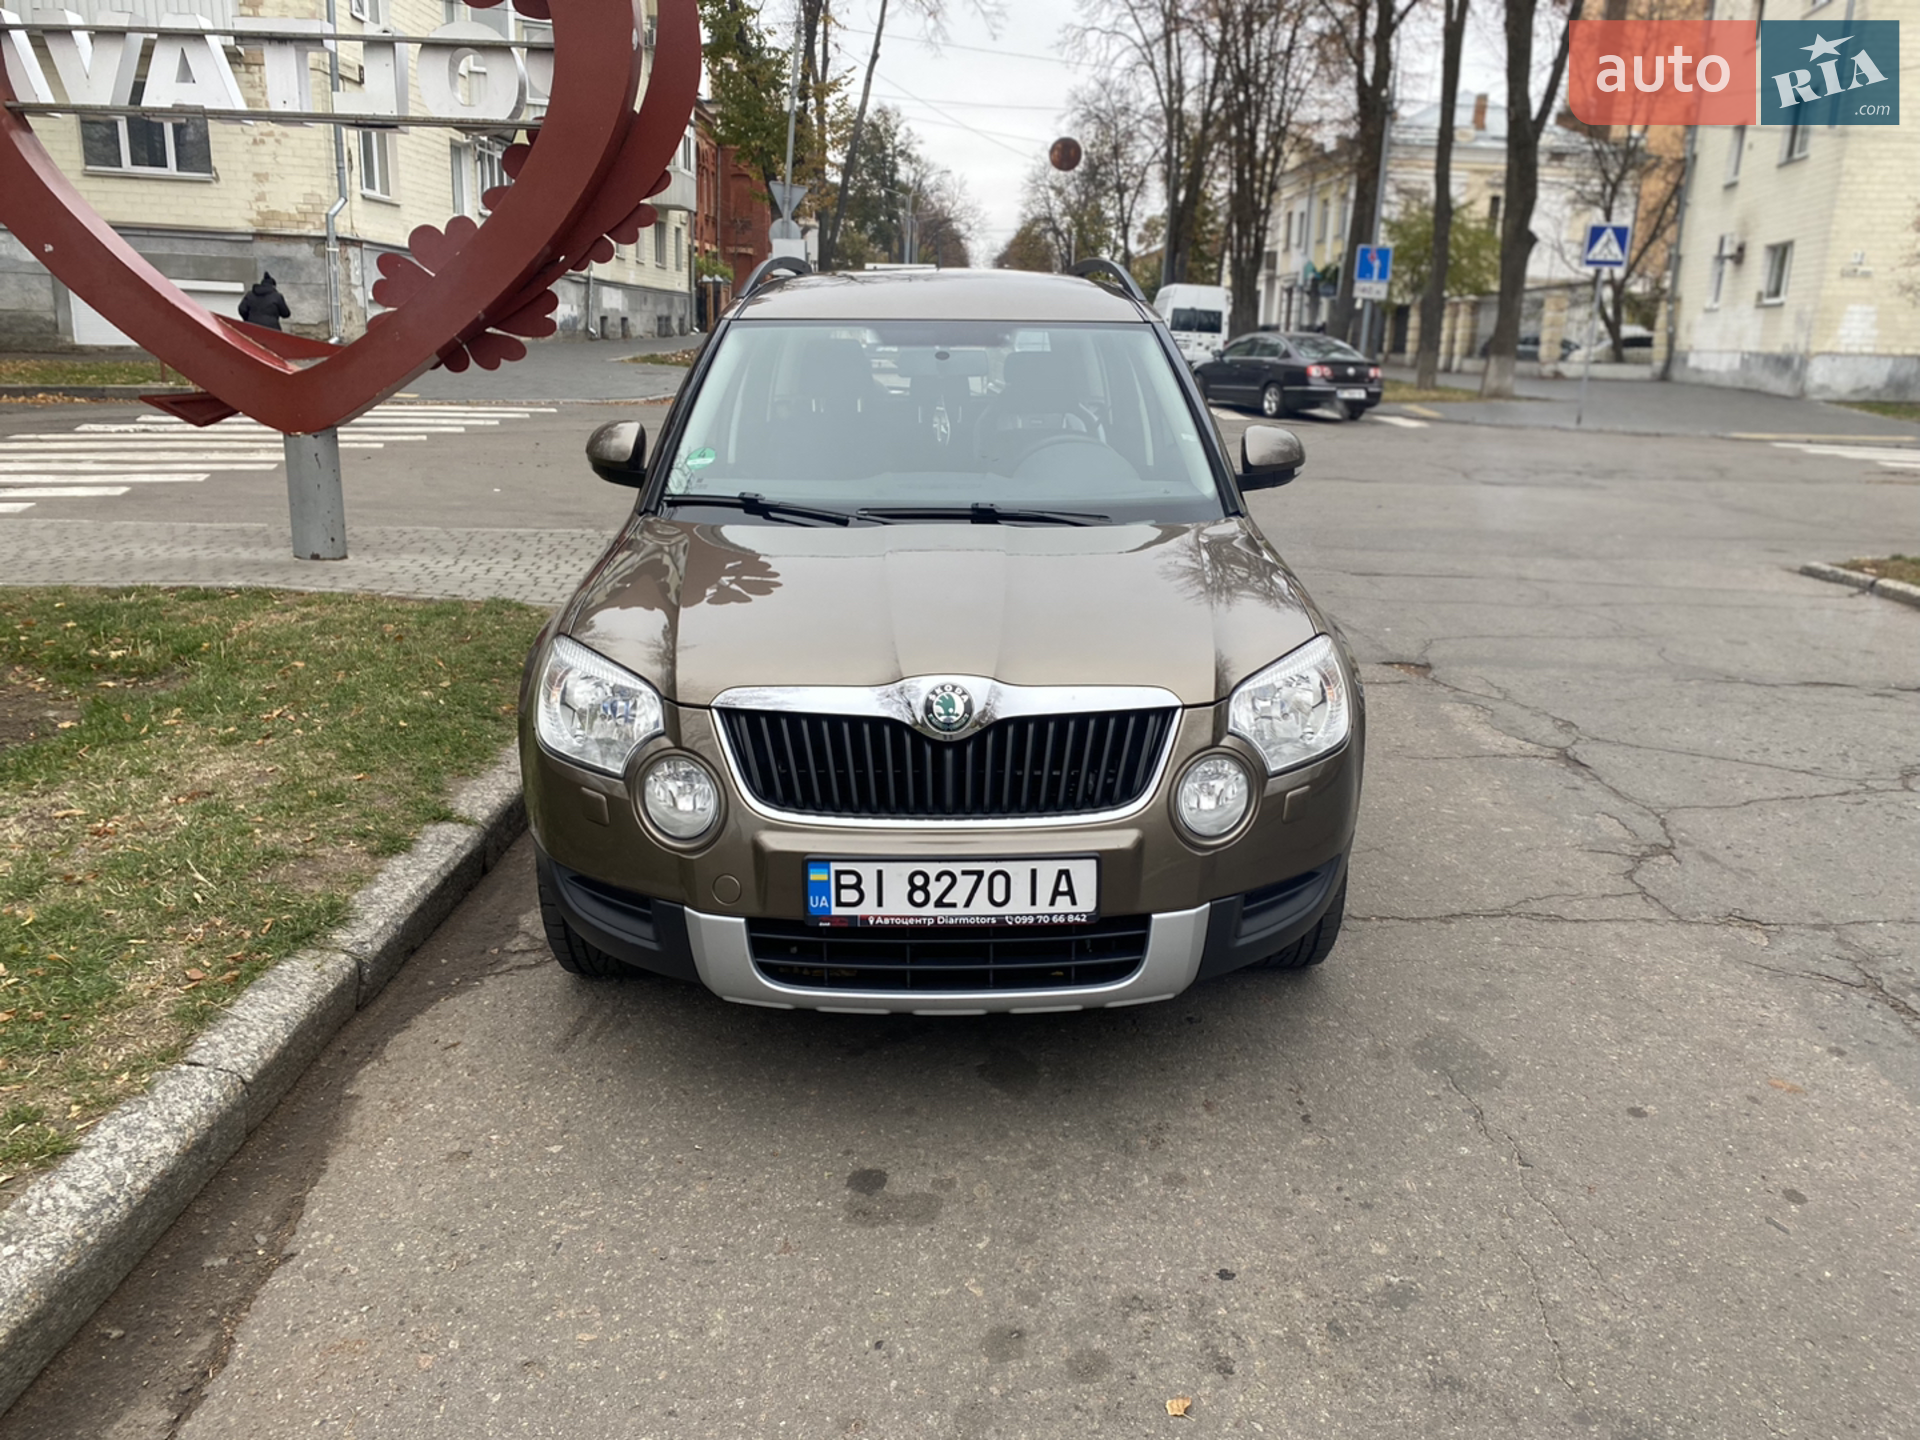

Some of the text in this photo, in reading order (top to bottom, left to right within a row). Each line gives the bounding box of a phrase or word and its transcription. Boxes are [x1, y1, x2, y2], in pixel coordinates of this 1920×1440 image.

[810, 868, 1078, 909] UA BI 8270 IA
[875, 913, 1087, 927] Автоцентр Diarmotors 099 70 66 842
